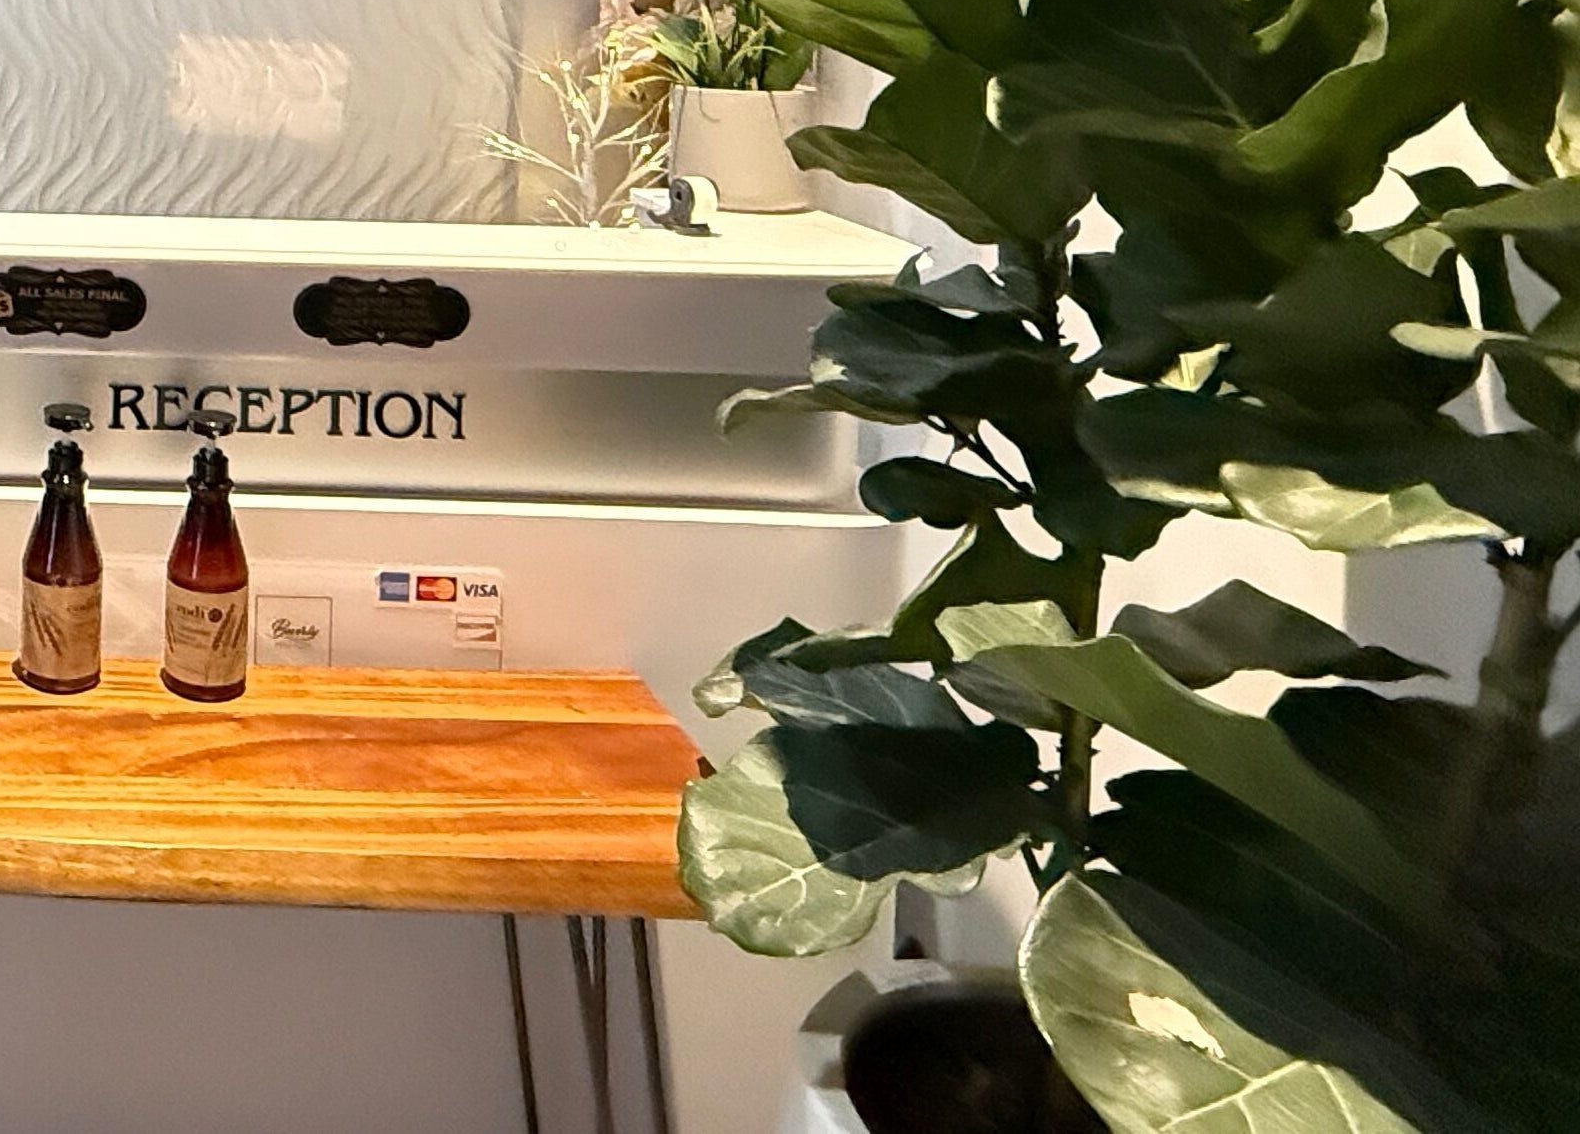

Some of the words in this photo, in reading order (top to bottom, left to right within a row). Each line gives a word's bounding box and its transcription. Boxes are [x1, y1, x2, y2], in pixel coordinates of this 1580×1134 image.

[18, 286, 41, 298] ALL
[43, 287, 85, 300] SALES
[463, 583, 499, 598] VISA
